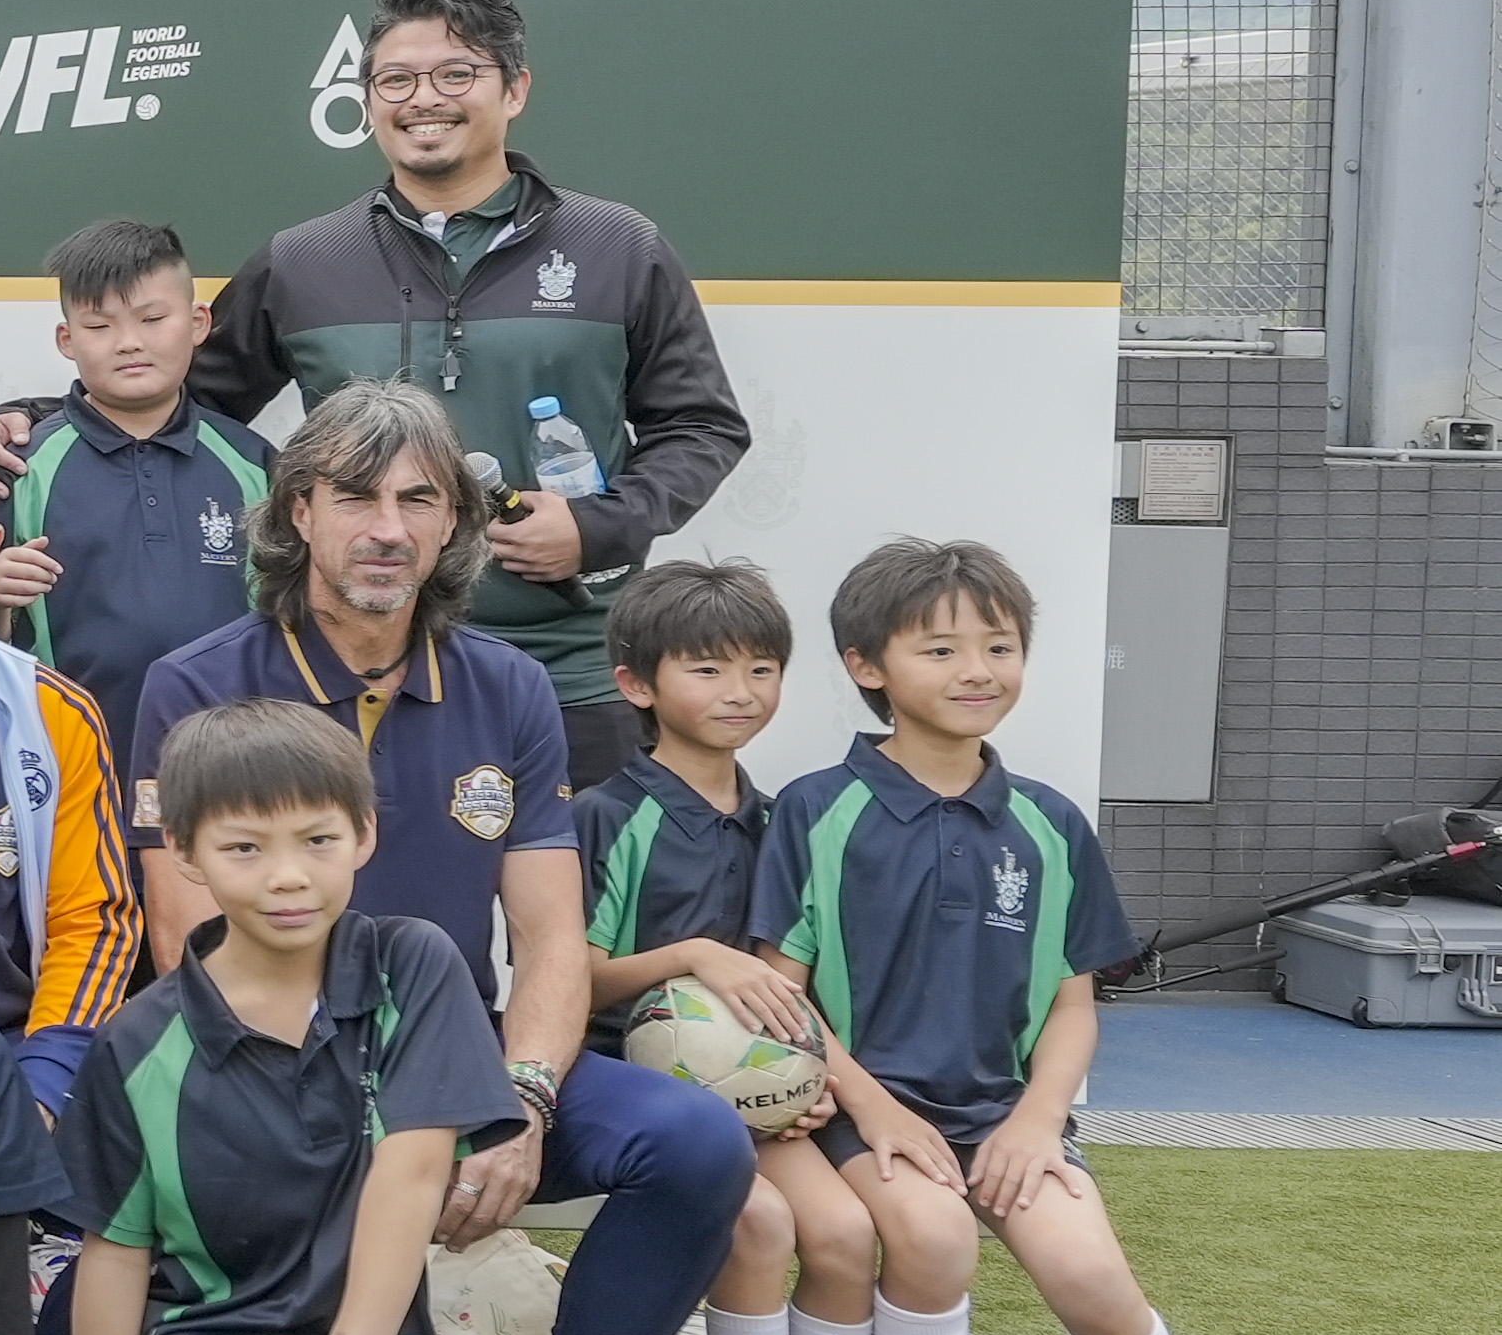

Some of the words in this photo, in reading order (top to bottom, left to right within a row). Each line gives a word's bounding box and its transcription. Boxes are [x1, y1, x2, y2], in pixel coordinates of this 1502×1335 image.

[132, 25, 187, 45] WORLD
[126, 42, 202, 64] FOOTBALL
[121, 61, 191, 83] LEGENDS
[531, 300, 576, 309] MALVERN
[736, 1081, 816, 1111] KELME
